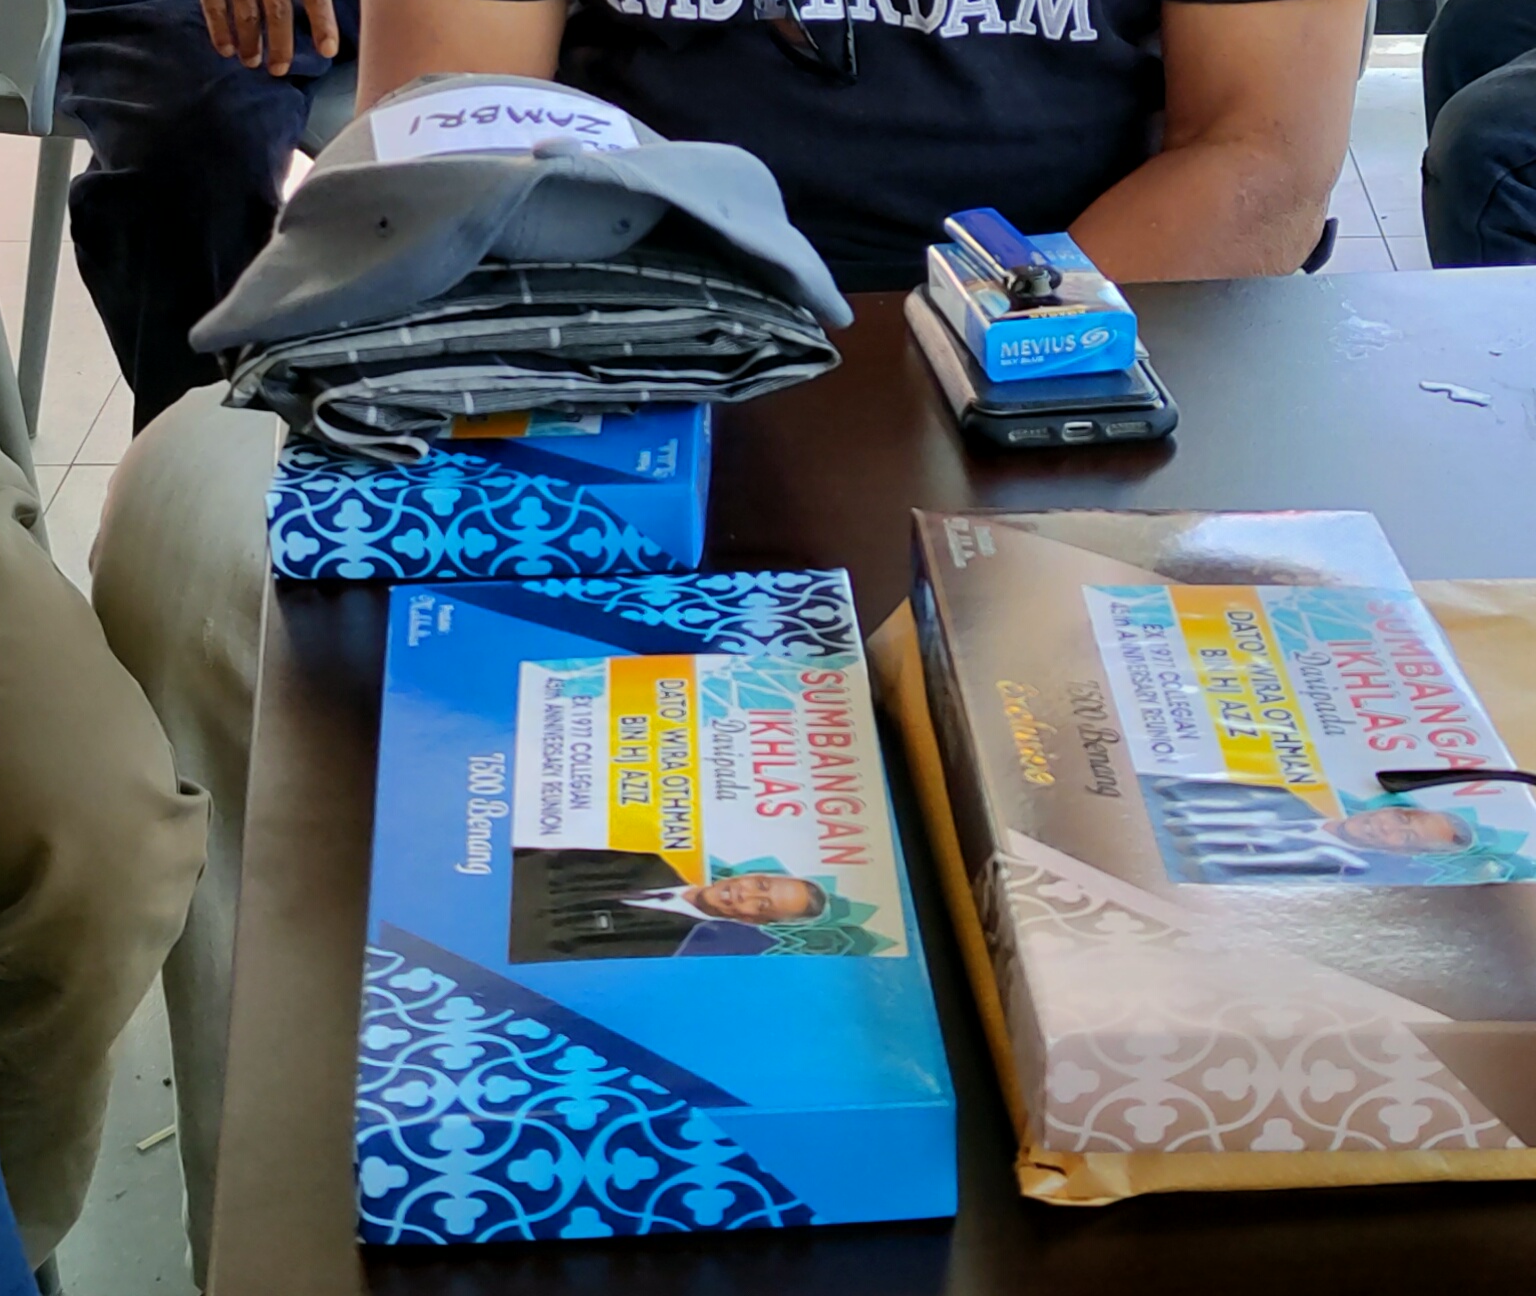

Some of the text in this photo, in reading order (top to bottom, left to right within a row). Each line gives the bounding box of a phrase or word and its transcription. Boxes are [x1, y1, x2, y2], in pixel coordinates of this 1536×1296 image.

[409, 105, 611, 135] ZAMBRI
[1000, 334, 1077, 359] MEVIUS
[1142, 623, 1168, 639] EX
[1158, 672, 1201, 740] COLLEGIAN
[1207, 677, 1239, 693] HJ
[1294, 651, 1356, 736] Daripada
[1328, 640, 1417, 752] IKHLAS
[541, 704, 564, 778] ANNIVERSARY
[570, 696, 592, 809] EX 1977 COLLEGIAN
[614, 717, 648, 804] BIN HJ AZIZ
[659, 728, 688, 770] WIRA
[704, 719, 748, 801] Daripada
[748, 710, 799, 818] IKHLAS
[800, 669, 869, 866] SUMBANGAN
[1078, 723, 1121, 797] Benang
[1142, 708, 1179, 765] REUNION
[1262, 709, 1317, 784] OTHMAN
[454, 753, 509, 875] 7500 Benang
[540, 782, 562, 835] REUNION
[660, 775, 691, 850] OTHMAN
